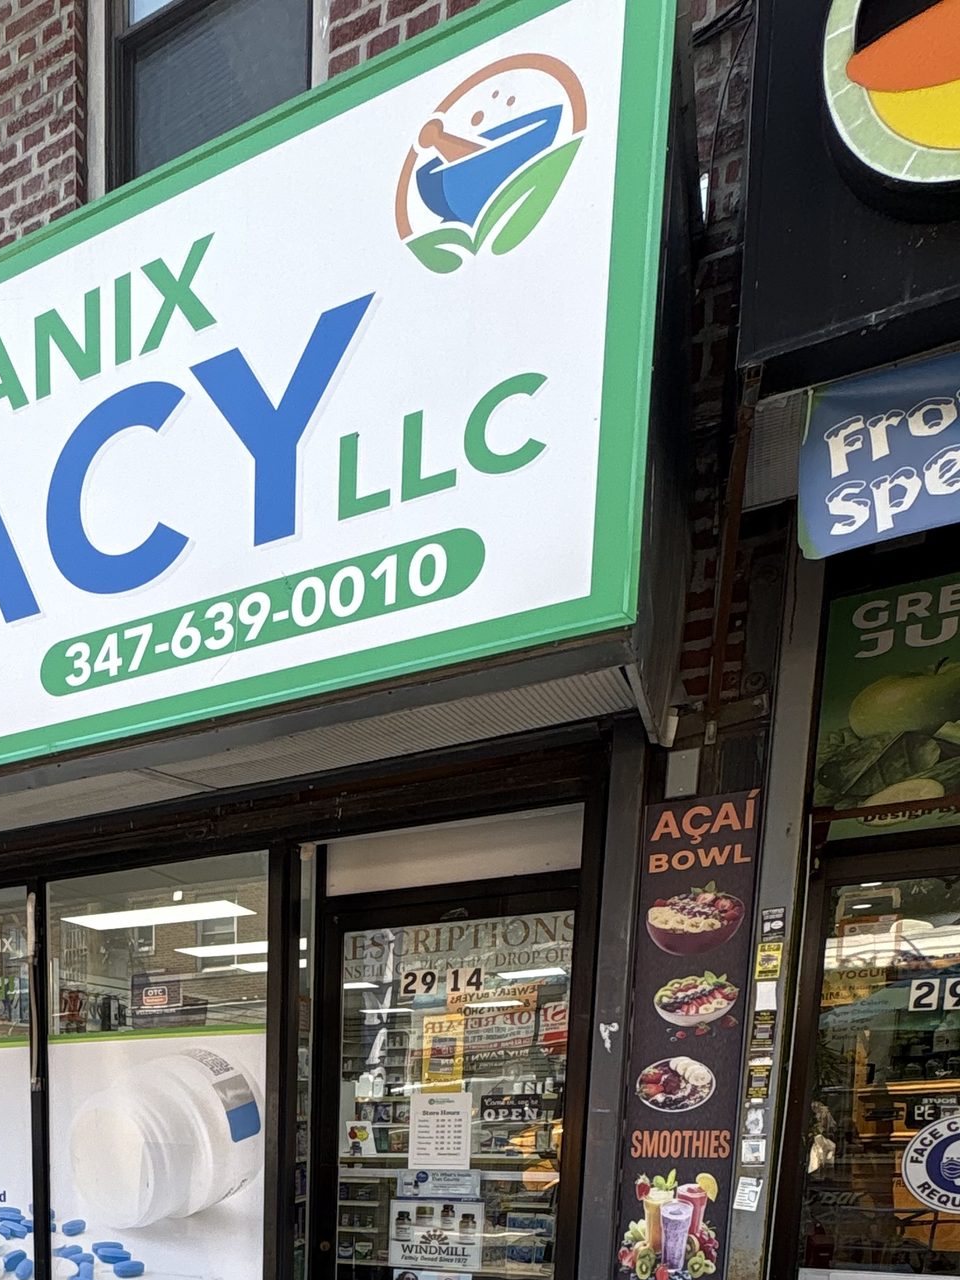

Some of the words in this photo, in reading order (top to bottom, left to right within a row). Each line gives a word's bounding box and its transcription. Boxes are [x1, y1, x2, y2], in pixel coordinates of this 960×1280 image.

[338, 372, 548, 521] LLC
[824, 391, 960, 478] Fro
[65, 543, 448, 686] 347-639-0010
[852, 583, 960, 630] GRE
[854, 615, 960, 660] JU
[650, 788, 761, 844] AÇAÍ
[648, 843, 752, 874] BOWL
[344, 913, 573, 961] ESCRIPTIONS
[495, 951, 540, 967] DROP
[483, 1107, 539, 1121] OPEN
[630, 1128, 730, 1159] SMOOTHIES
[910, 1128, 943, 1165] FACE
[401, 1244, 470, 1257] WINDMILL
